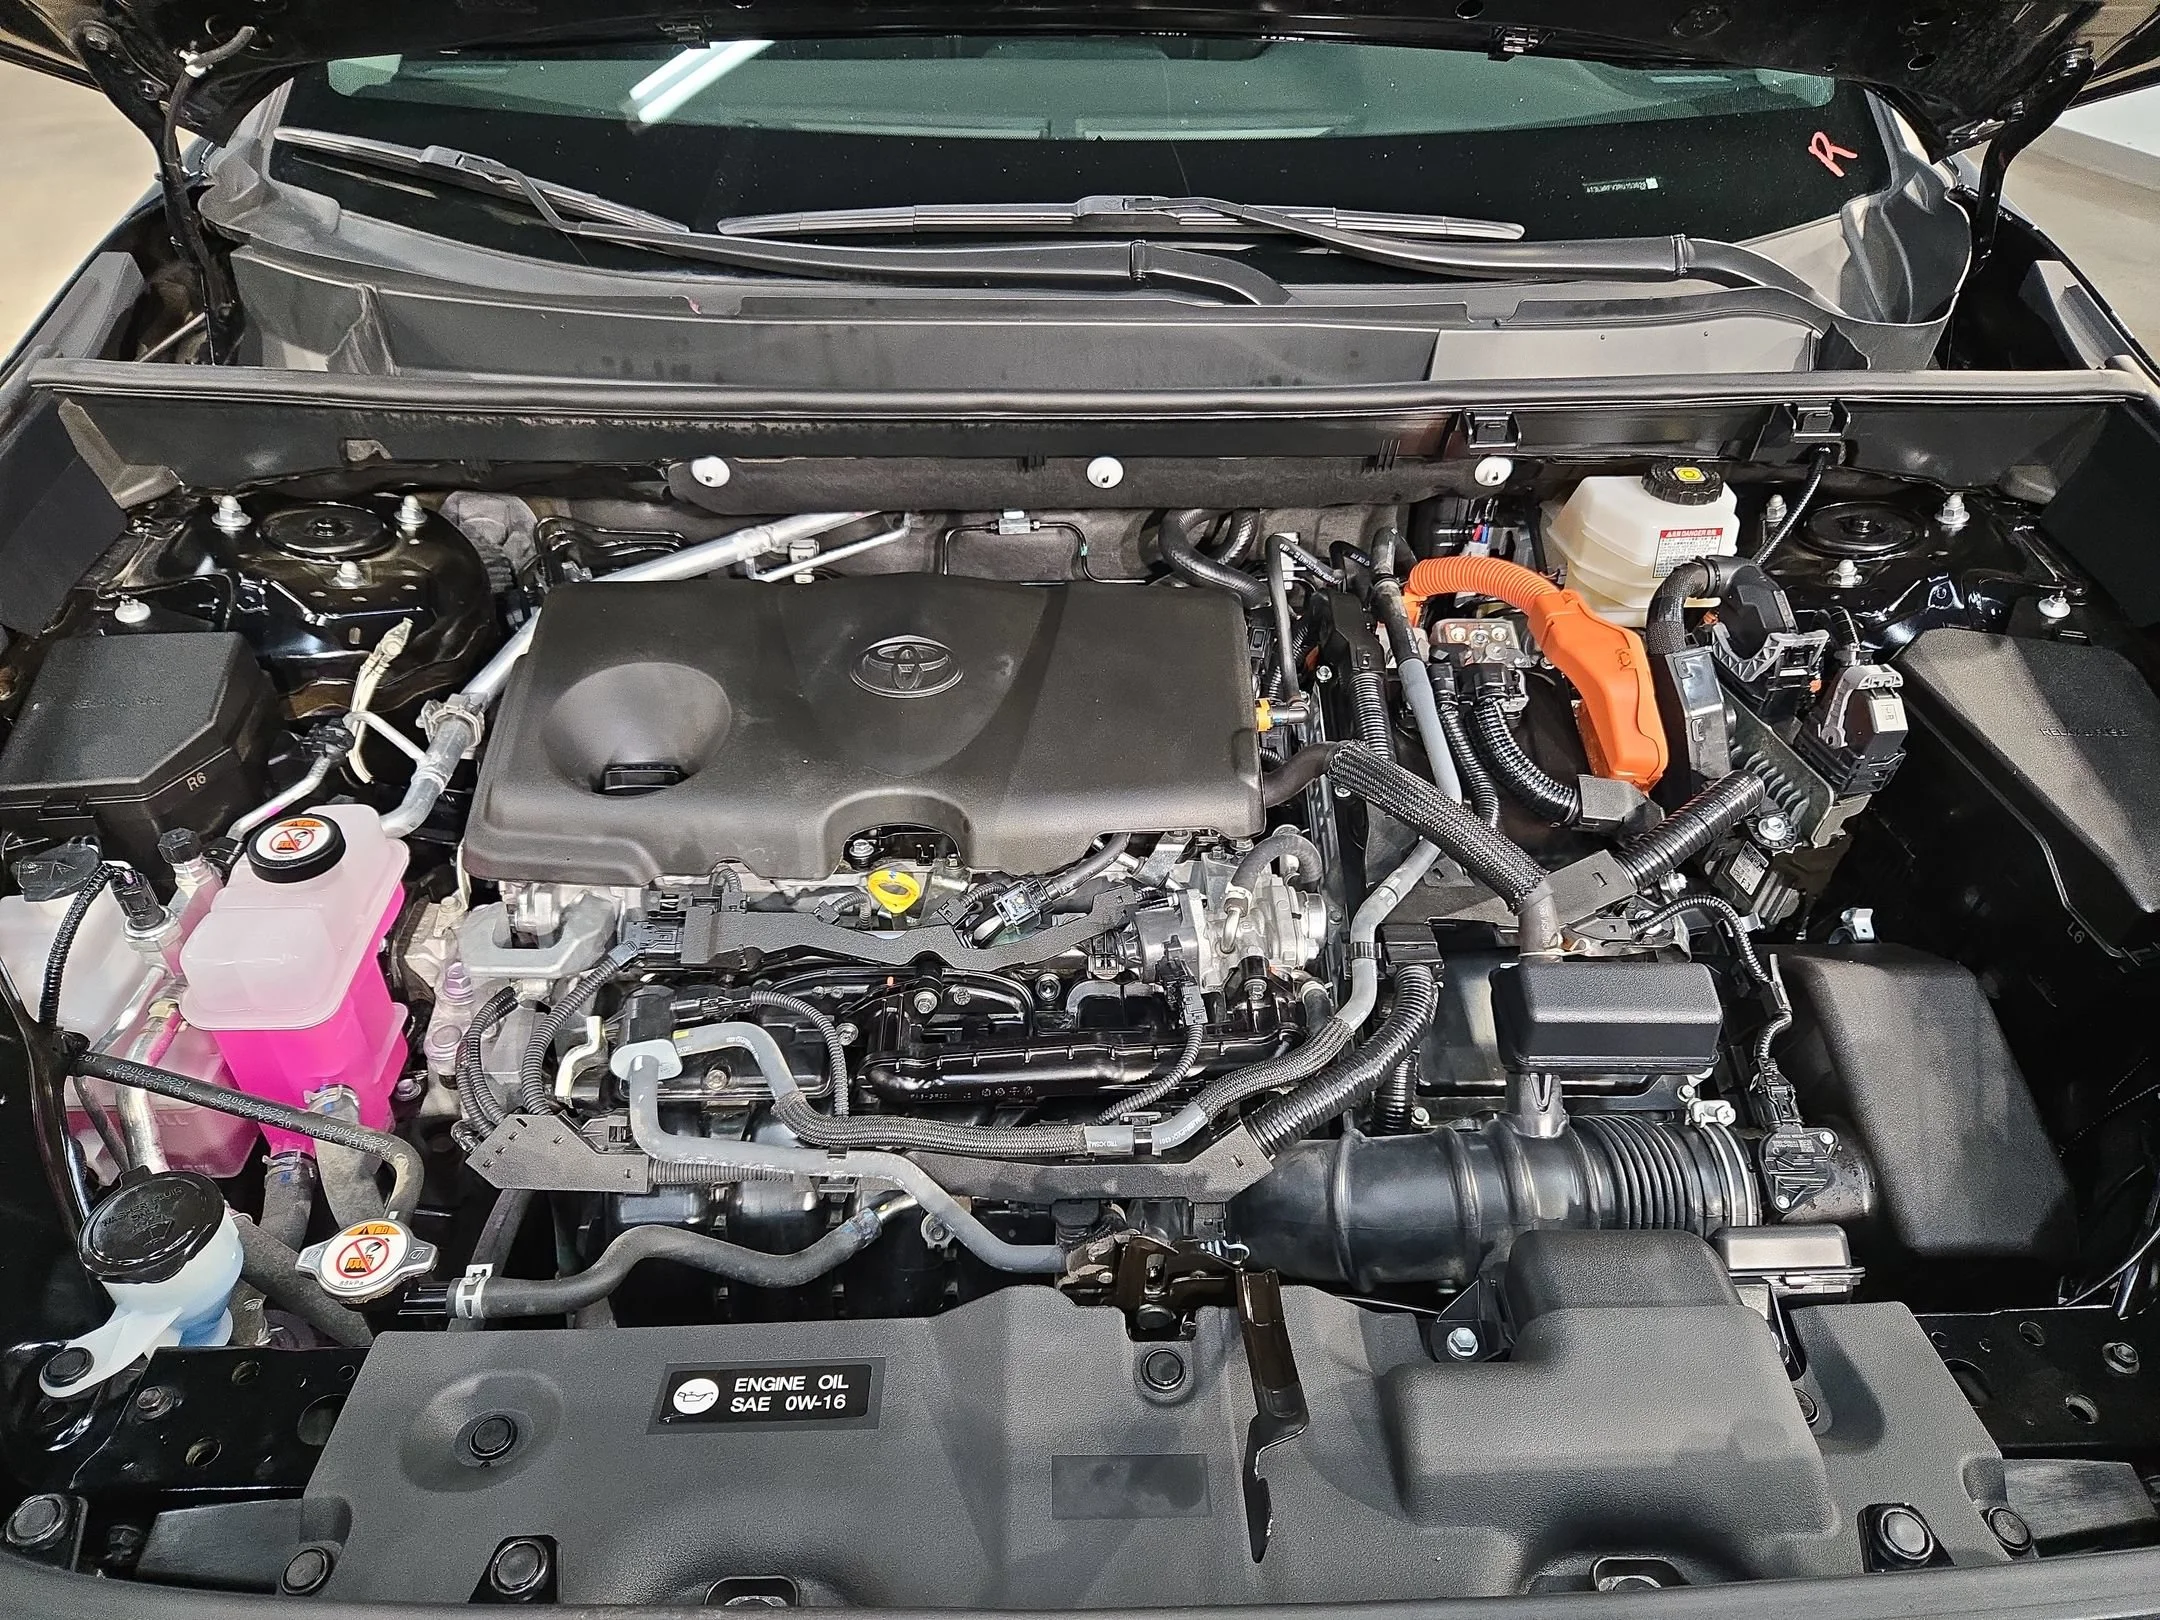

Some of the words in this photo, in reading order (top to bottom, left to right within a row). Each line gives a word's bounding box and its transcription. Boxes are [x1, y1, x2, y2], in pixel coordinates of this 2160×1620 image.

[1808, 131, 1857, 177] R
[1681, 529, 1706, 538] DANGER
[186, 771, 207, 791] R6
[2066, 921, 2085, 944] L6
[117, 1062, 190, 1088] 16283-F0060
[344, 1137, 377, 1153] WATER
[101, 1201, 148, 1227] WASHER
[734, 1376, 806, 1393] ENGINE
[818, 1374, 849, 1390] OIL
[730, 1396, 771, 1413] SAE
[785, 1394, 846, 1411] 0W-16
